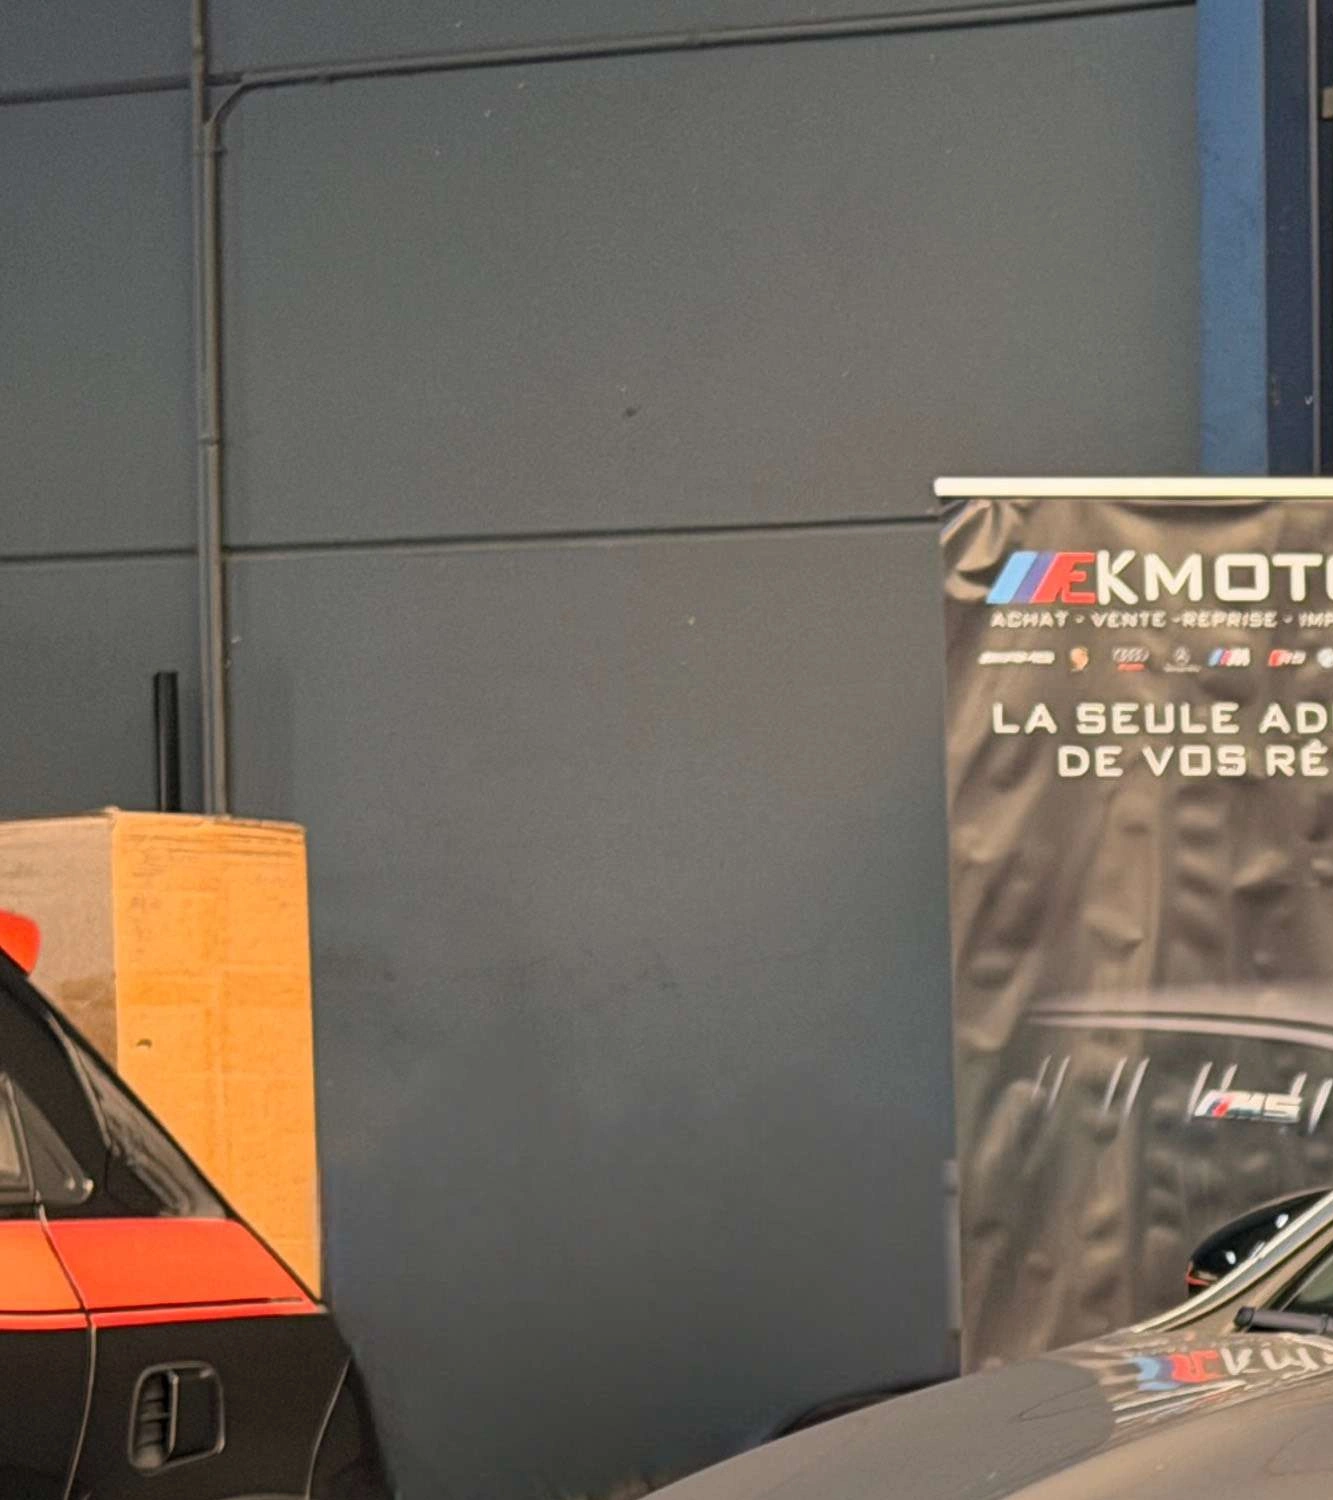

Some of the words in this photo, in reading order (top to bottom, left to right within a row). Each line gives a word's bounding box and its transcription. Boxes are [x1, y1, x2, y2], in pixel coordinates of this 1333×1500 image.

[990, 610, 1069, 628] ACHAT
[1091, 610, 1166, 628] VENTE
[992, 702, 1057, 734] LA
[1076, 702, 1240, 735] SEULE
[1058, 745, 1124, 777] DE
[1142, 744, 1247, 777] VOS
